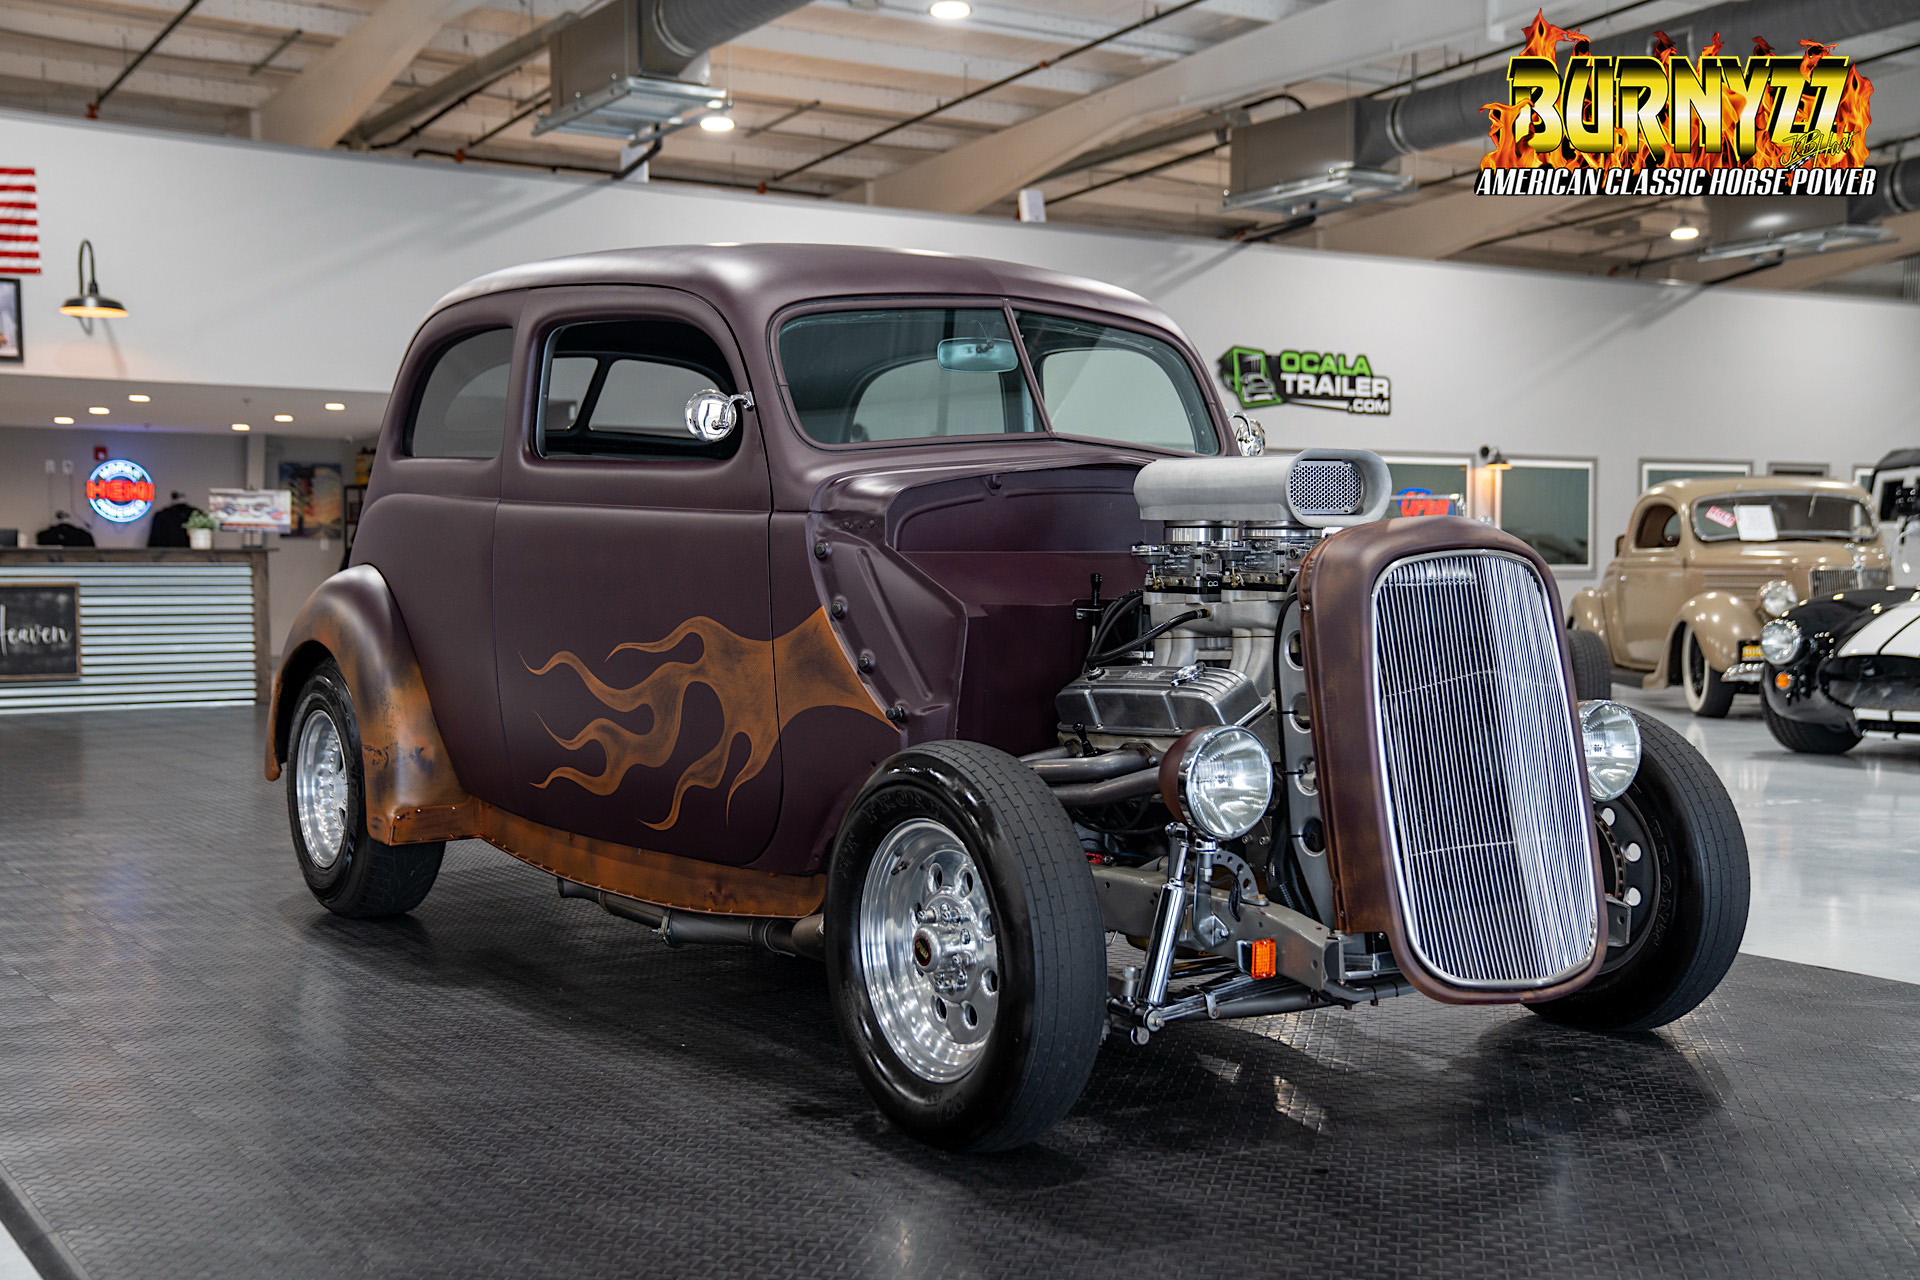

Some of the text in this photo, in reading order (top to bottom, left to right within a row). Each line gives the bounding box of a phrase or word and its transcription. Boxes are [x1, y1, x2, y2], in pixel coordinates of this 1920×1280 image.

[1280, 351, 1371, 376] OCALA
[1280, 373, 1389, 399] TRAILER
[1349, 398, 1389, 413] .COM
[87, 480, 154, 501] HEMI
